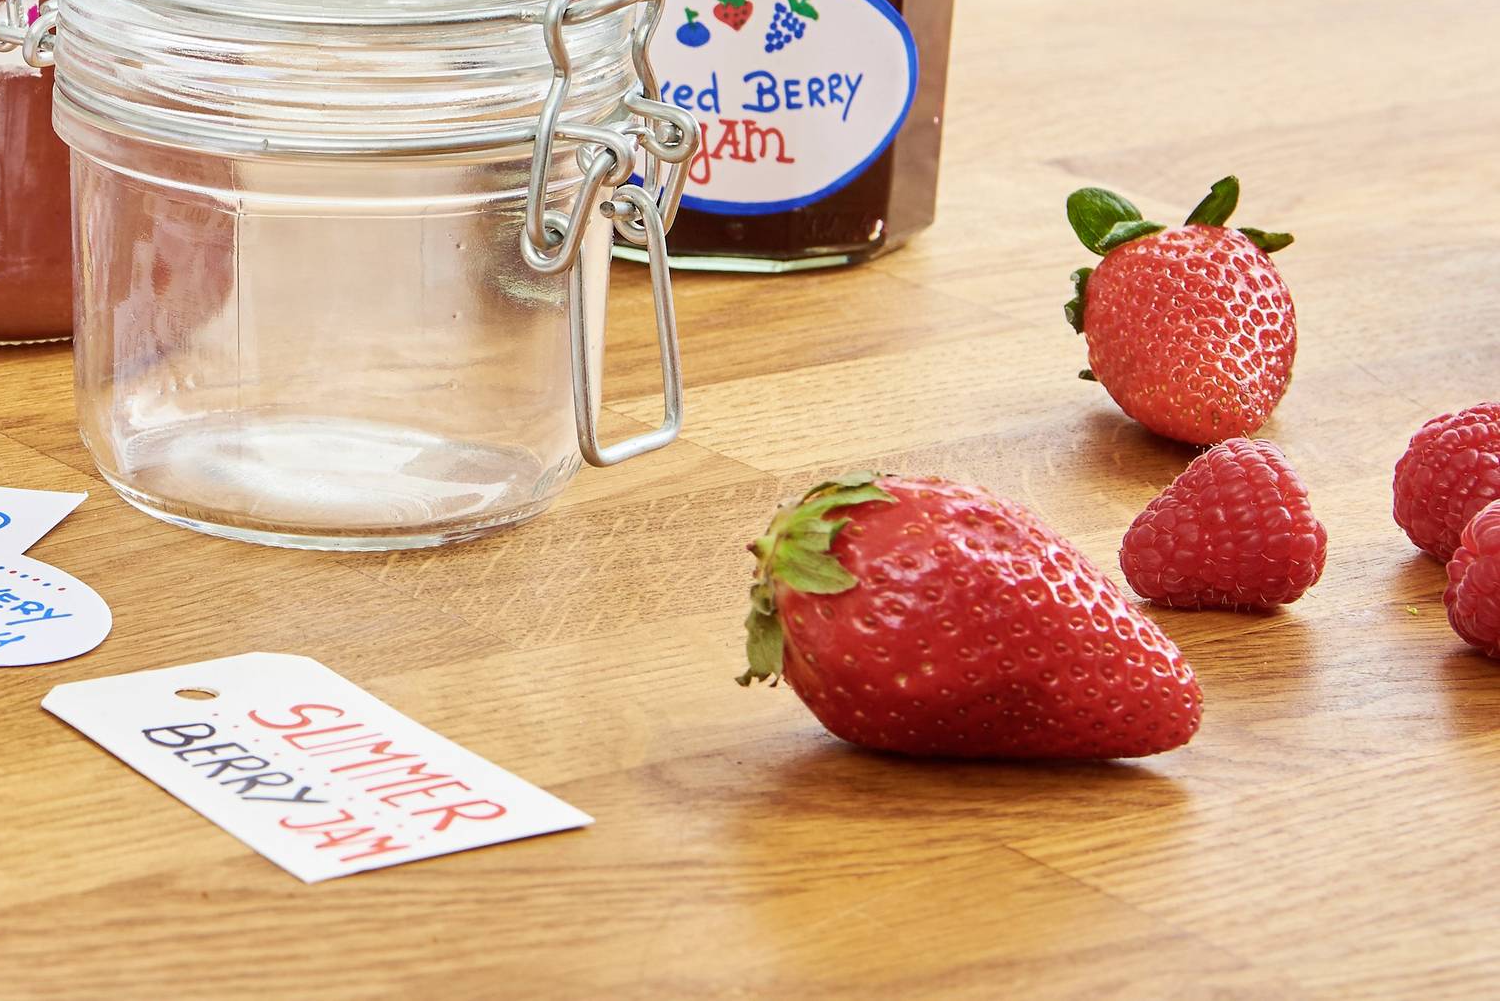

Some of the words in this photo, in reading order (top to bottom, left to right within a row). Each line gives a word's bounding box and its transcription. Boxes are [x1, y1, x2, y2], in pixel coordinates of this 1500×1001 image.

[742, 70, 863, 122] BERRY
[142, 722, 330, 806] BERRY
[278, 808, 412, 863] JAM
[248, 702, 508, 832] SUMMER
